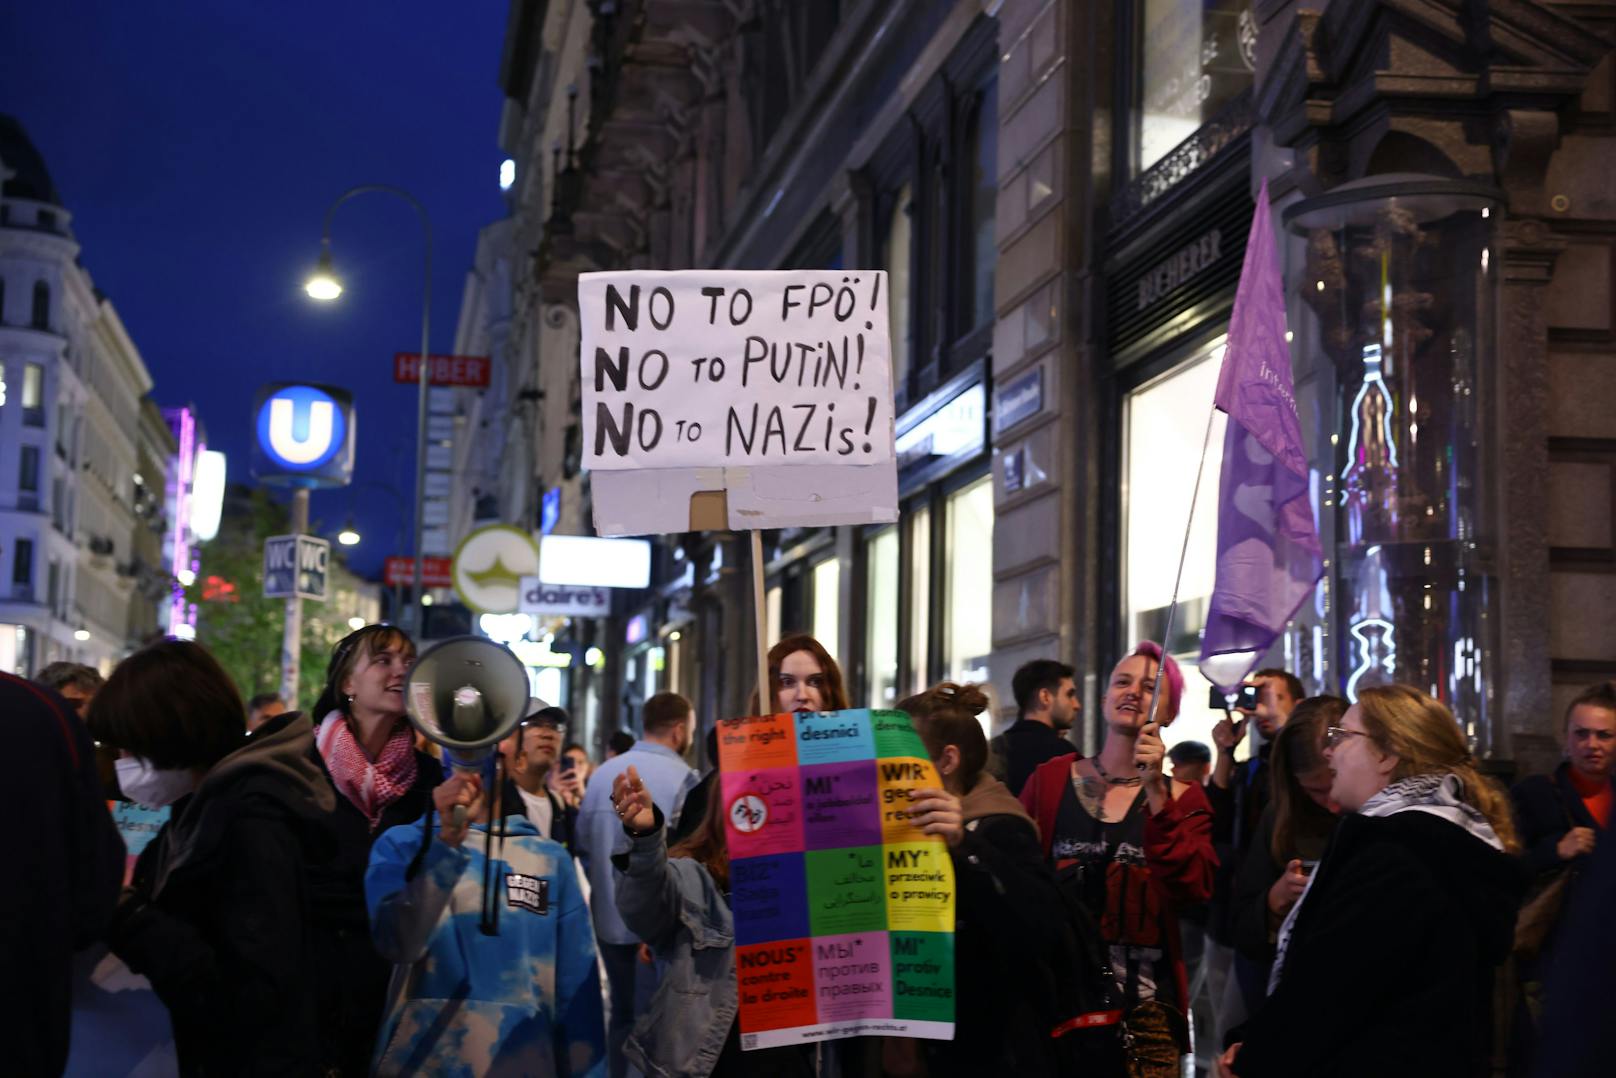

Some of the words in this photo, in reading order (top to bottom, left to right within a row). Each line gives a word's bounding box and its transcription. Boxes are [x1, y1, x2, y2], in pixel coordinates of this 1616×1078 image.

[605, 284, 675, 332] NO
[701, 286, 753, 326] TO
[594, 346, 669, 392] NO
[269, 398, 334, 464] U
[594, 401, 663, 457] NO
[268, 541, 295, 569] WC
[300, 543, 327, 573] WC
[749, 727, 786, 744] right
[800, 723, 860, 742] desnici
[883, 788, 916, 804] geg
[818, 962, 880, 981] против
